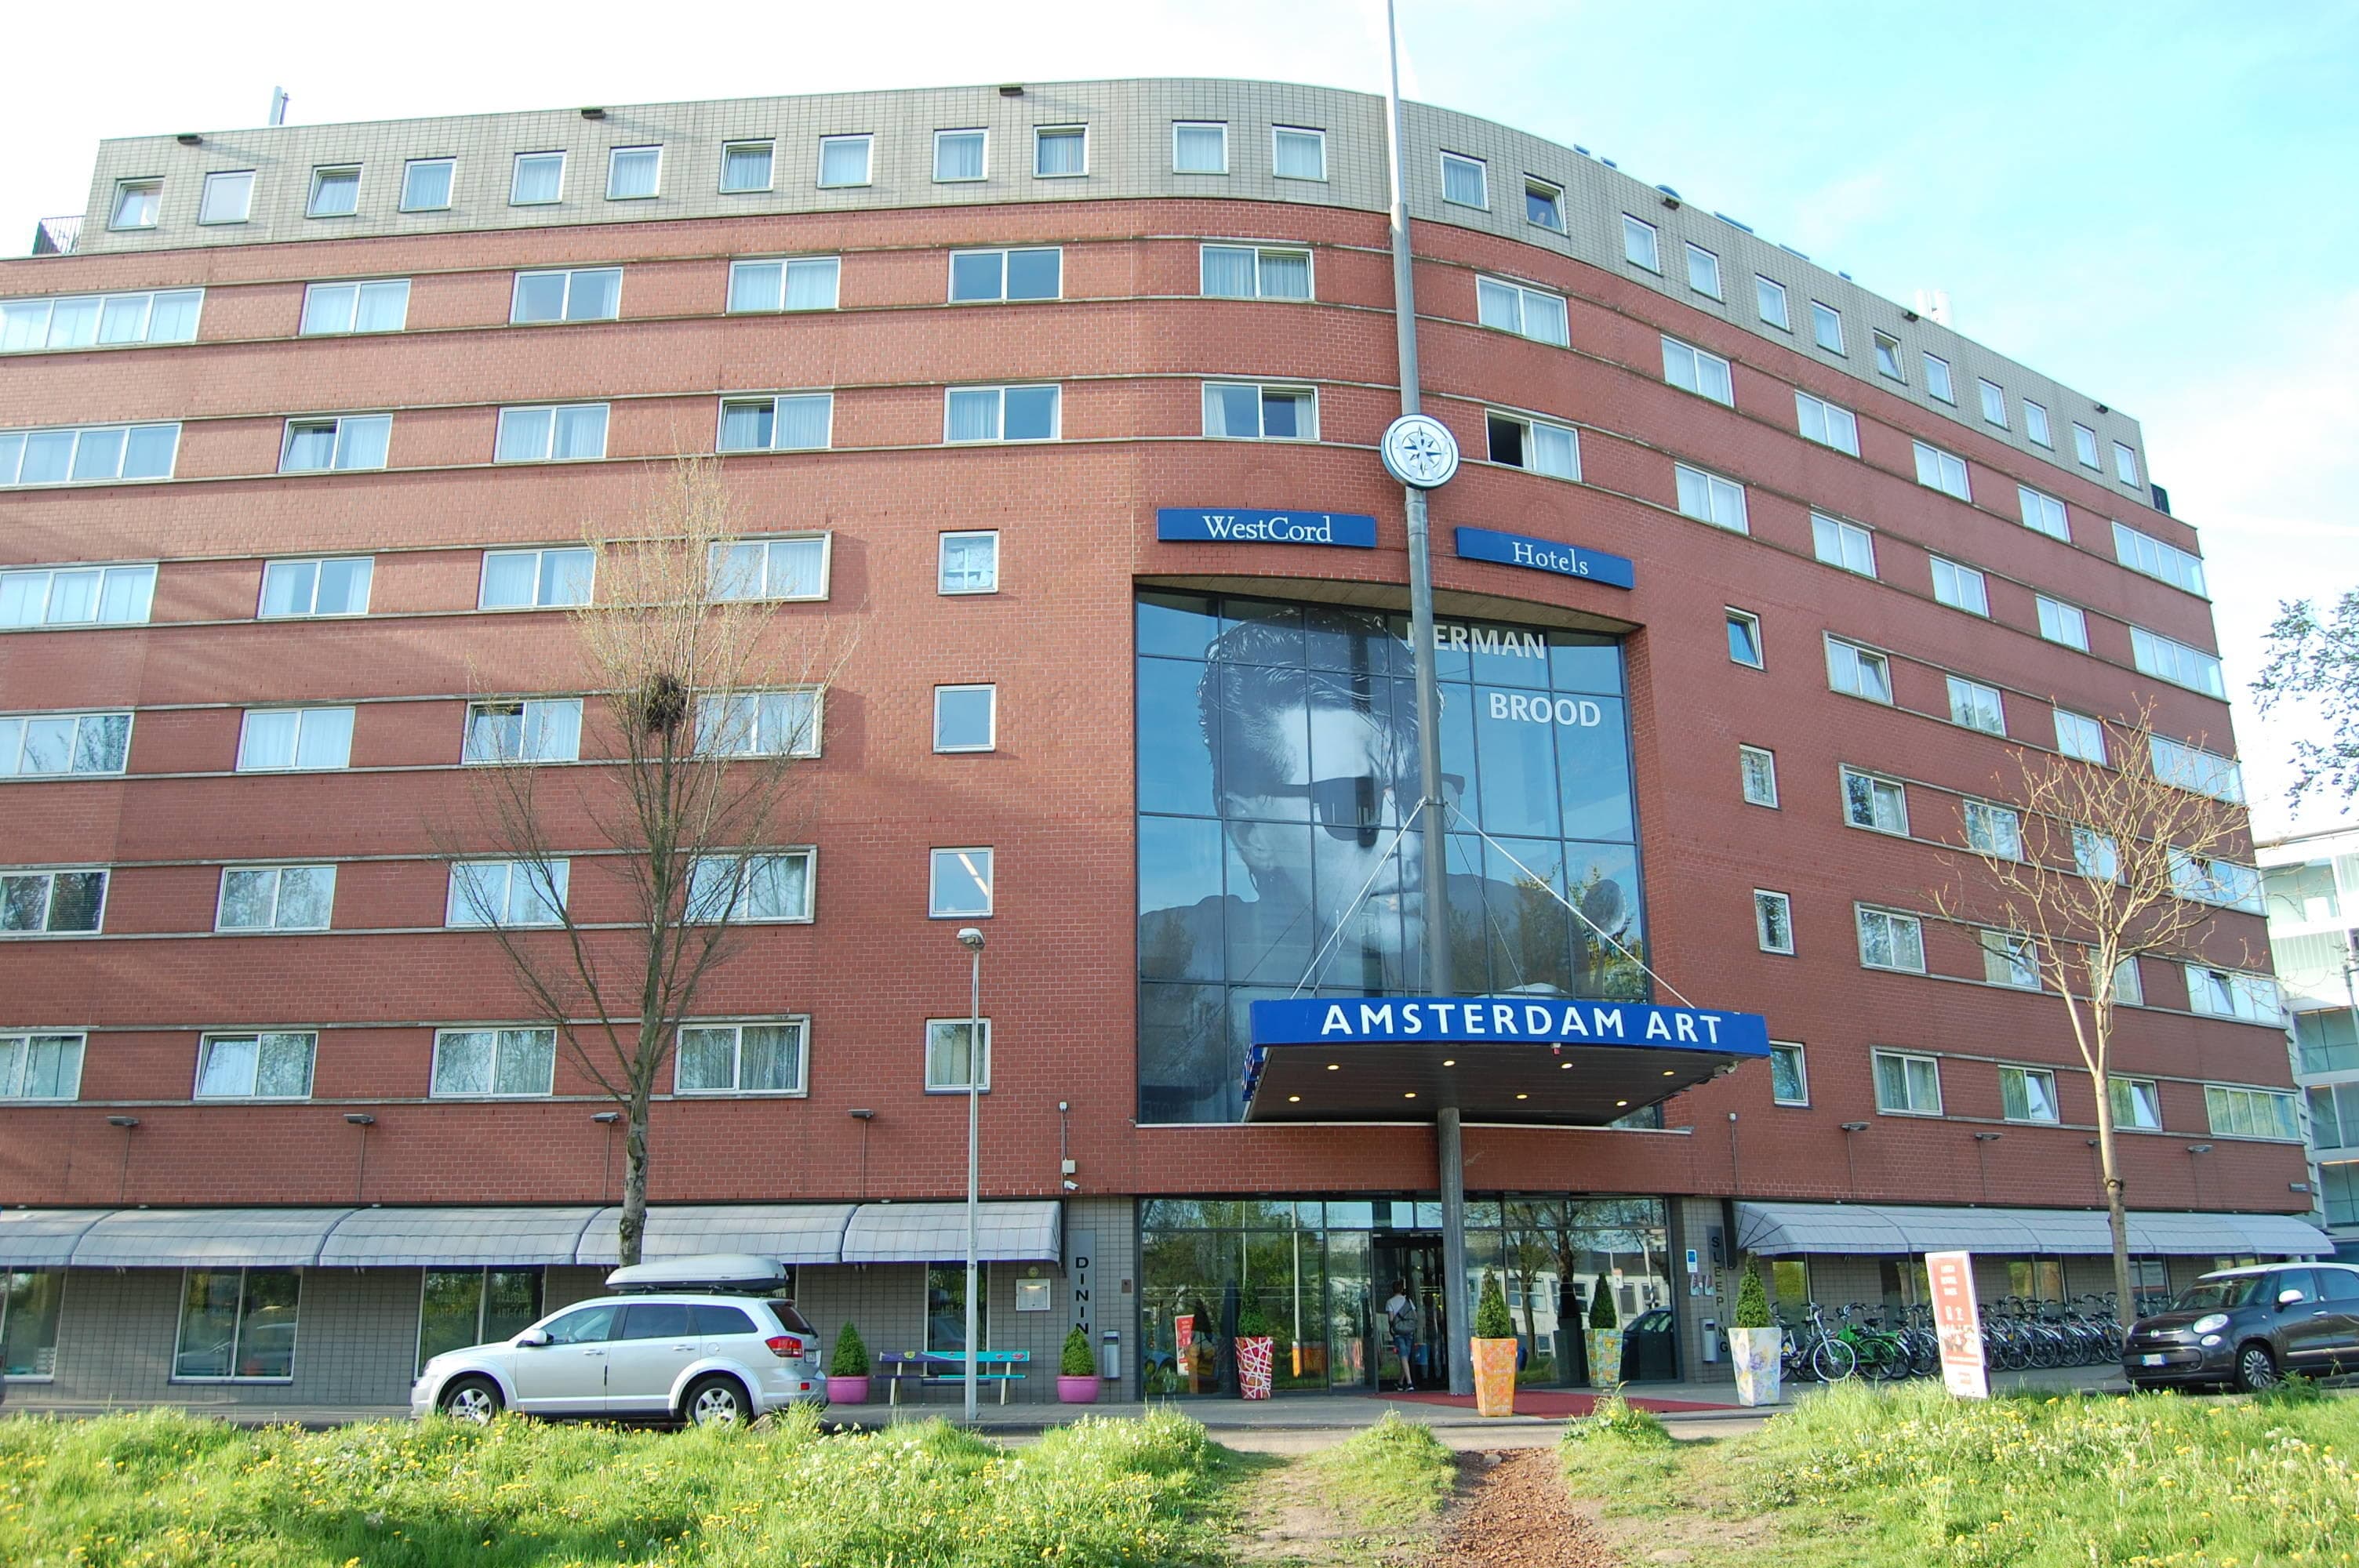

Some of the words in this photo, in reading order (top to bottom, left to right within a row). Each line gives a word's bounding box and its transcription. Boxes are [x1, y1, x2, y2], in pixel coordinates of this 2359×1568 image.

[1203, 514, 1333, 543] WestCord
[1512, 541, 1590, 575] Hotels
[1490, 692, 1601, 727] BROOD
[1321, 1004, 1625, 1039] AMSTERDAM
[1645, 1010, 1722, 1044] ART
[1075, 1257, 1089, 1334] DININ
[1711, 1236, 1728, 1352] SLEEPING
